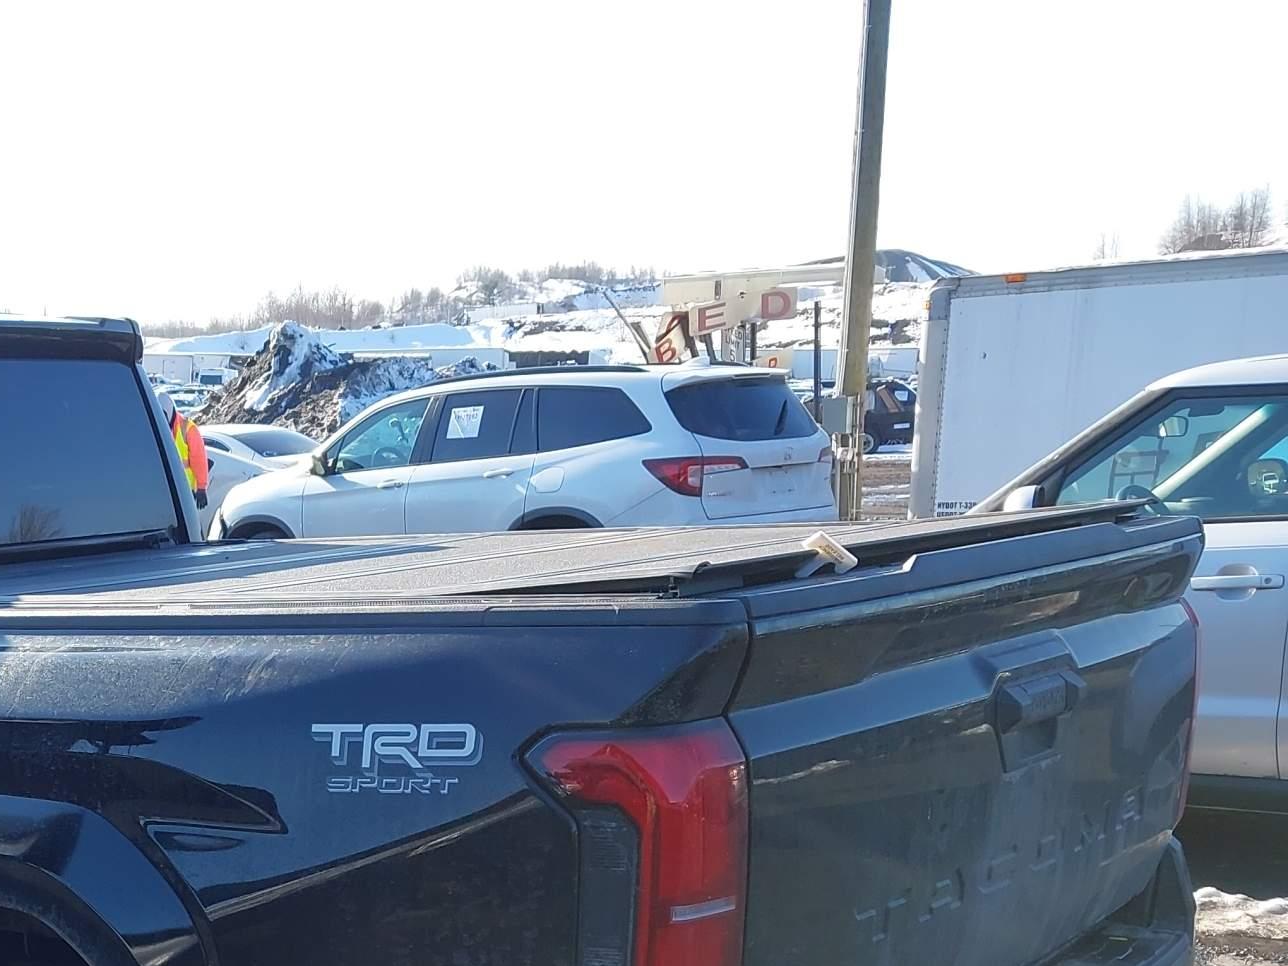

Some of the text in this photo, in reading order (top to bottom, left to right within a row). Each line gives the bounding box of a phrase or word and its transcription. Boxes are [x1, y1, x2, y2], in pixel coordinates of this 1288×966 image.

[312, 723, 483, 777] TRD
[327, 776, 459, 794] SPORT
[855, 787, 1143, 943] TACOMA
